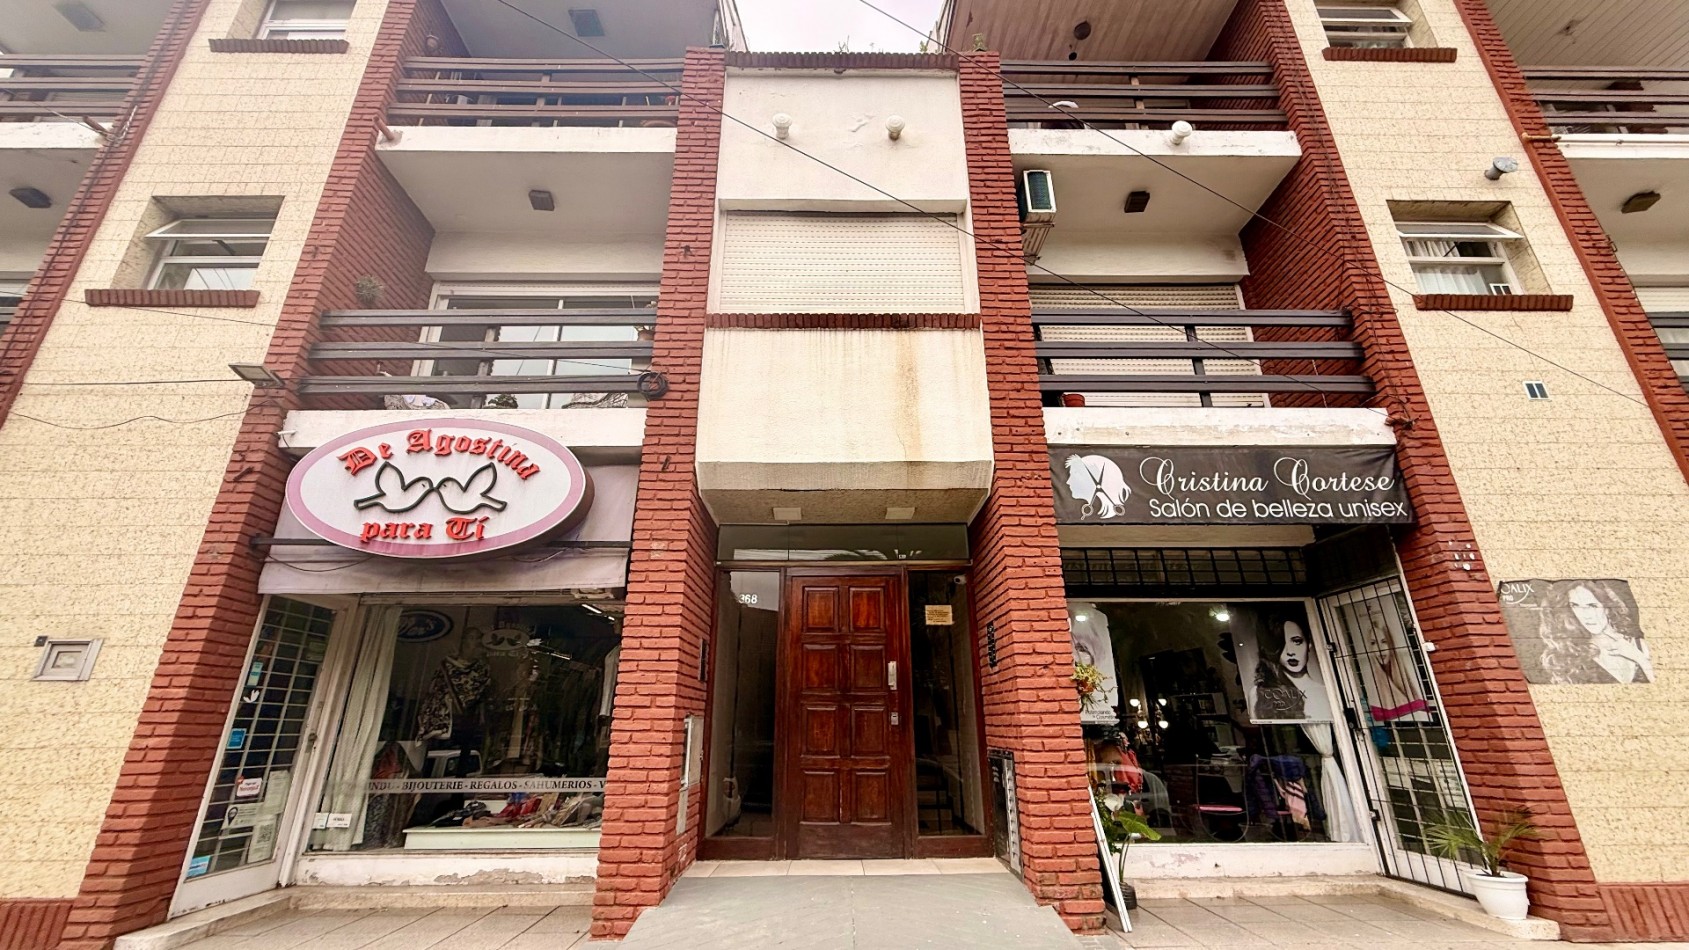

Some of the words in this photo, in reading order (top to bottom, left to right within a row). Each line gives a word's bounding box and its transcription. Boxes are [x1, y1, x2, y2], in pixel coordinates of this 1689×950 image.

[336, 442, 394, 476] De
[406, 428, 541, 480] Agostina
[1139, 456, 1269, 500] Cristina
[1274, 456, 1395, 500] Cortese
[1149, 497, 1211, 518] Salón
[1216, 499, 1247, 518] de
[1251, 499, 1334, 518] belleza
[1338, 498, 1408, 518] unisex
[360, 522, 434, 544] para
[738, 593, 758, 604] 368
[402, 780, 463, 792] BIJOUTERIE
[469, 780, 517, 790] REGALOS
[523, 780, 592, 790] SAHUMERIOS
